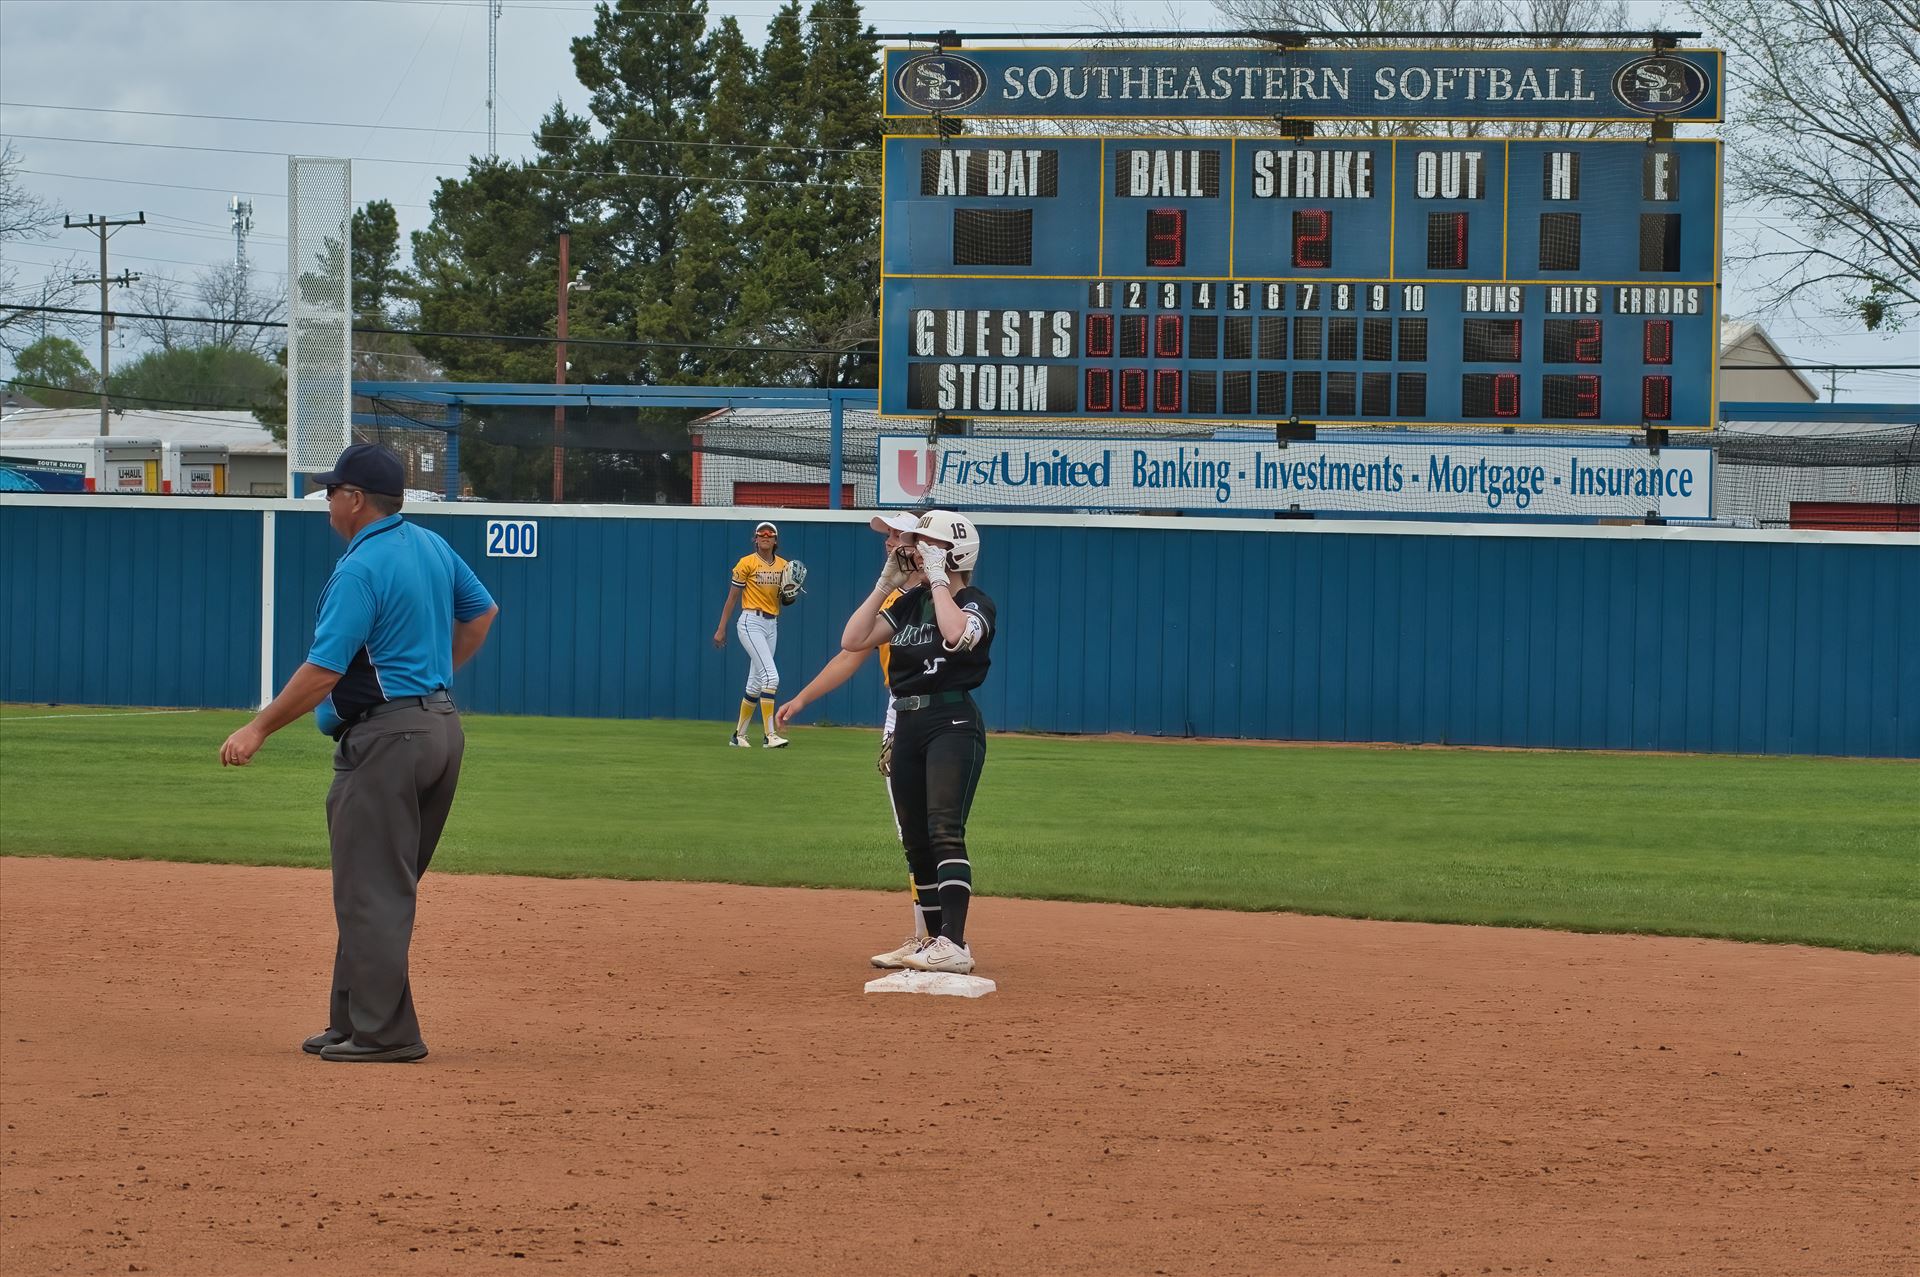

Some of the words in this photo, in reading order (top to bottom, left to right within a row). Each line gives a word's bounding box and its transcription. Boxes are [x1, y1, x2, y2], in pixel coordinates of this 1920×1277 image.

[1002, 66, 1352, 101] SOUTHEASTERN
[1374, 67, 1596, 102] SOFTBALL
[937, 149, 971, 196] AT
[988, 149, 1042, 197] BAT
[1130, 150, 1204, 197] BALL
[1255, 150, 1371, 199] STRIKE
[1417, 151, 1482, 199] OUT
[1551, 152, 1571, 200] H
[1152, 208, 1183, 266] 3
[1296, 209, 1327, 268] 2
[1096, 282, 1105, 308] 1
[1129, 282, 1141, 309] 2
[1164, 283, 1175, 309] 3
[1198, 283, 1210, 309] 4
[1233, 283, 1245, 310] 5
[1267, 283, 1279, 310] 6
[1303, 284, 1314, 310] 7
[1337, 284, 1349, 311] 8
[1372, 285, 1384, 311] 9
[1404, 285, 1423, 312] 10
[1466, 286, 1521, 313] RUNS
[1551, 287, 1598, 313] HITS
[1619, 287, 1699, 314] ERRORS
[916, 309, 1072, 357] GUESTS
[1088, 314, 1111, 355] 0
[1157, 315, 1180, 356] 0
[1575, 319, 1600, 361] 2
[1646, 320, 1671, 363] 0
[937, 363, 1048, 411] STORM
[1088, 369, 1110, 409] 0
[1122, 369, 1145, 410] 0
[1156, 370, 1179, 411] 0
[1494, 373, 1518, 416] 0
[1576, 374, 1599, 417] 3
[1645, 374, 1670, 418] 0
[118, 469, 142, 479] U-HAUL
[1132, 447, 1231, 503] Banking
[1255, 451, 1403, 493] Investments
[1427, 454, 1545, 509] Mortgage
[1570, 456, 1693, 498] Insurance
[489, 523, 536, 555] 200
[950, 522, 967, 540] 16
